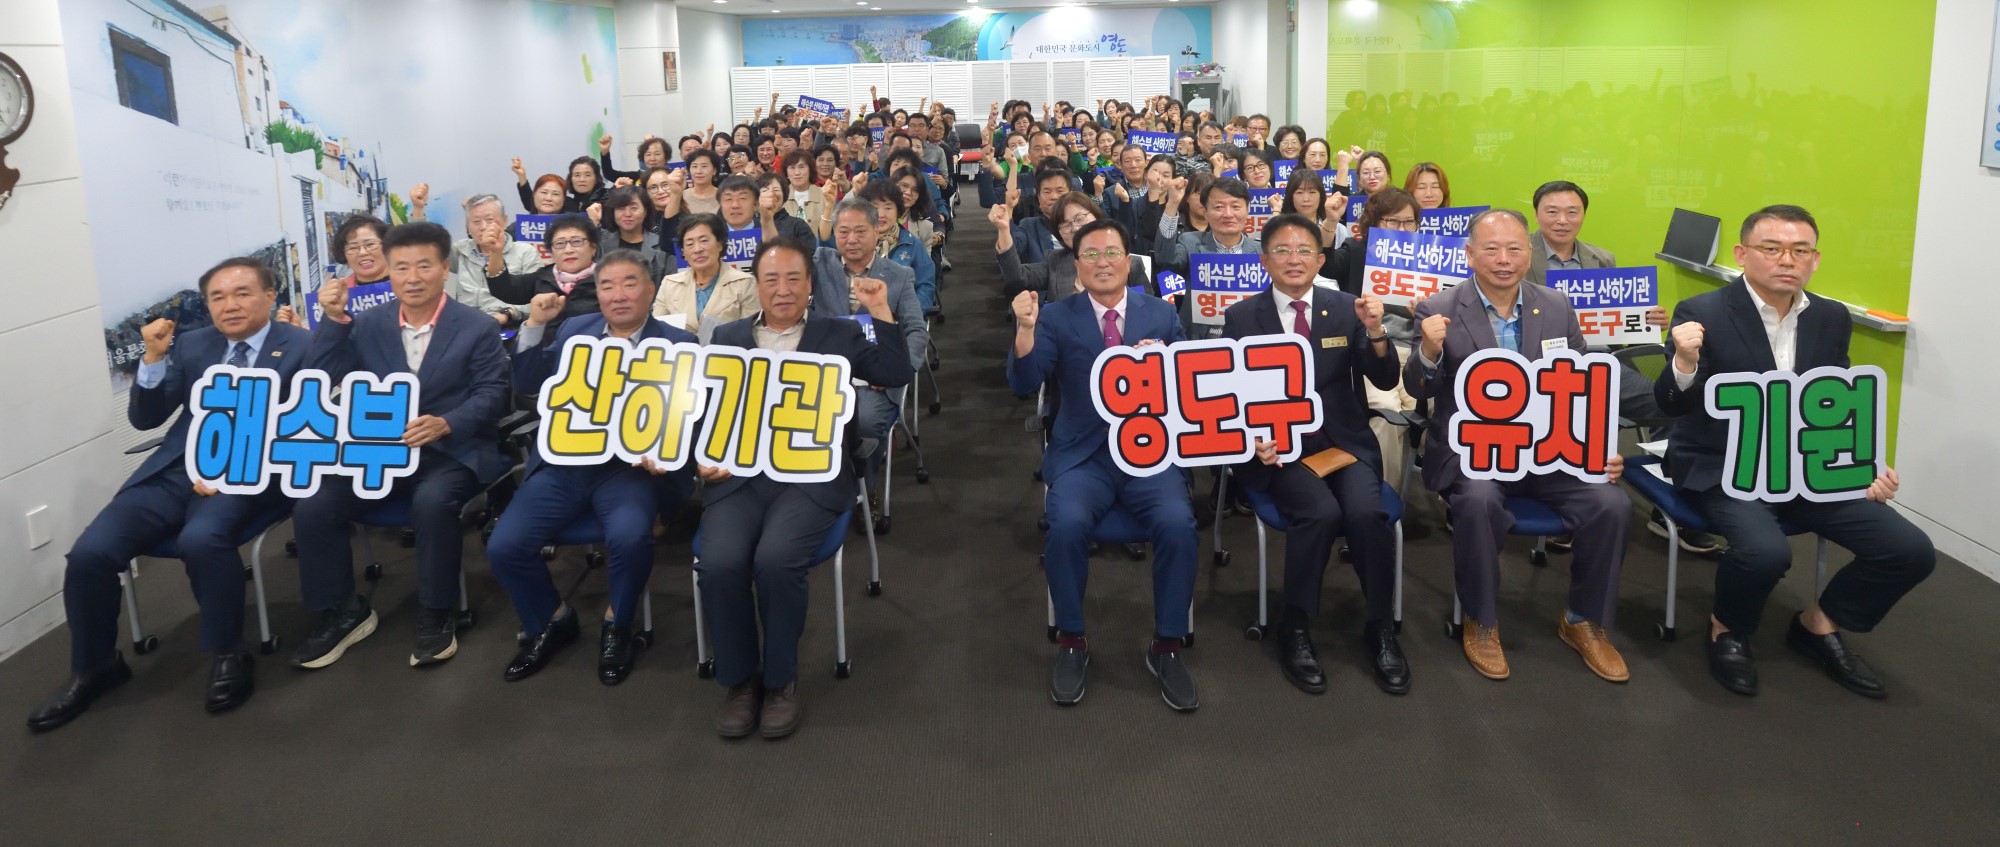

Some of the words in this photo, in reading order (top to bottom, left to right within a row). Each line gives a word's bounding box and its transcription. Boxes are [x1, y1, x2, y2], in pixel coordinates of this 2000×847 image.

[1036, 44, 1067, 53] 대한민국
[1069, 43, 1100, 52] 문화도시
[1101, 33, 1127, 53] 영도
[1132, 135, 1152, 151] 해수부
[1153, 137, 1176, 152] 산하기관
[1248, 195, 1269, 213] 수부
[1417, 216, 1441, 236] 수부
[721, 237, 757, 259] 하기관
[1375, 238, 1415, 267] 해수부
[1416, 243, 1470, 275] 산하기관
[1198, 262, 1236, 289] 해수부
[1554, 278, 1597, 306] 해수부
[1597, 275, 1651, 305] 산하기관
[547, 343, 847, 474] 산하기관
[1099, 341, 1315, 468] 영도구
[1458, 356, 1612, 475] 유치
[195, 372, 412, 491] 해수부
[1714, 374, 1878, 494] 기원
